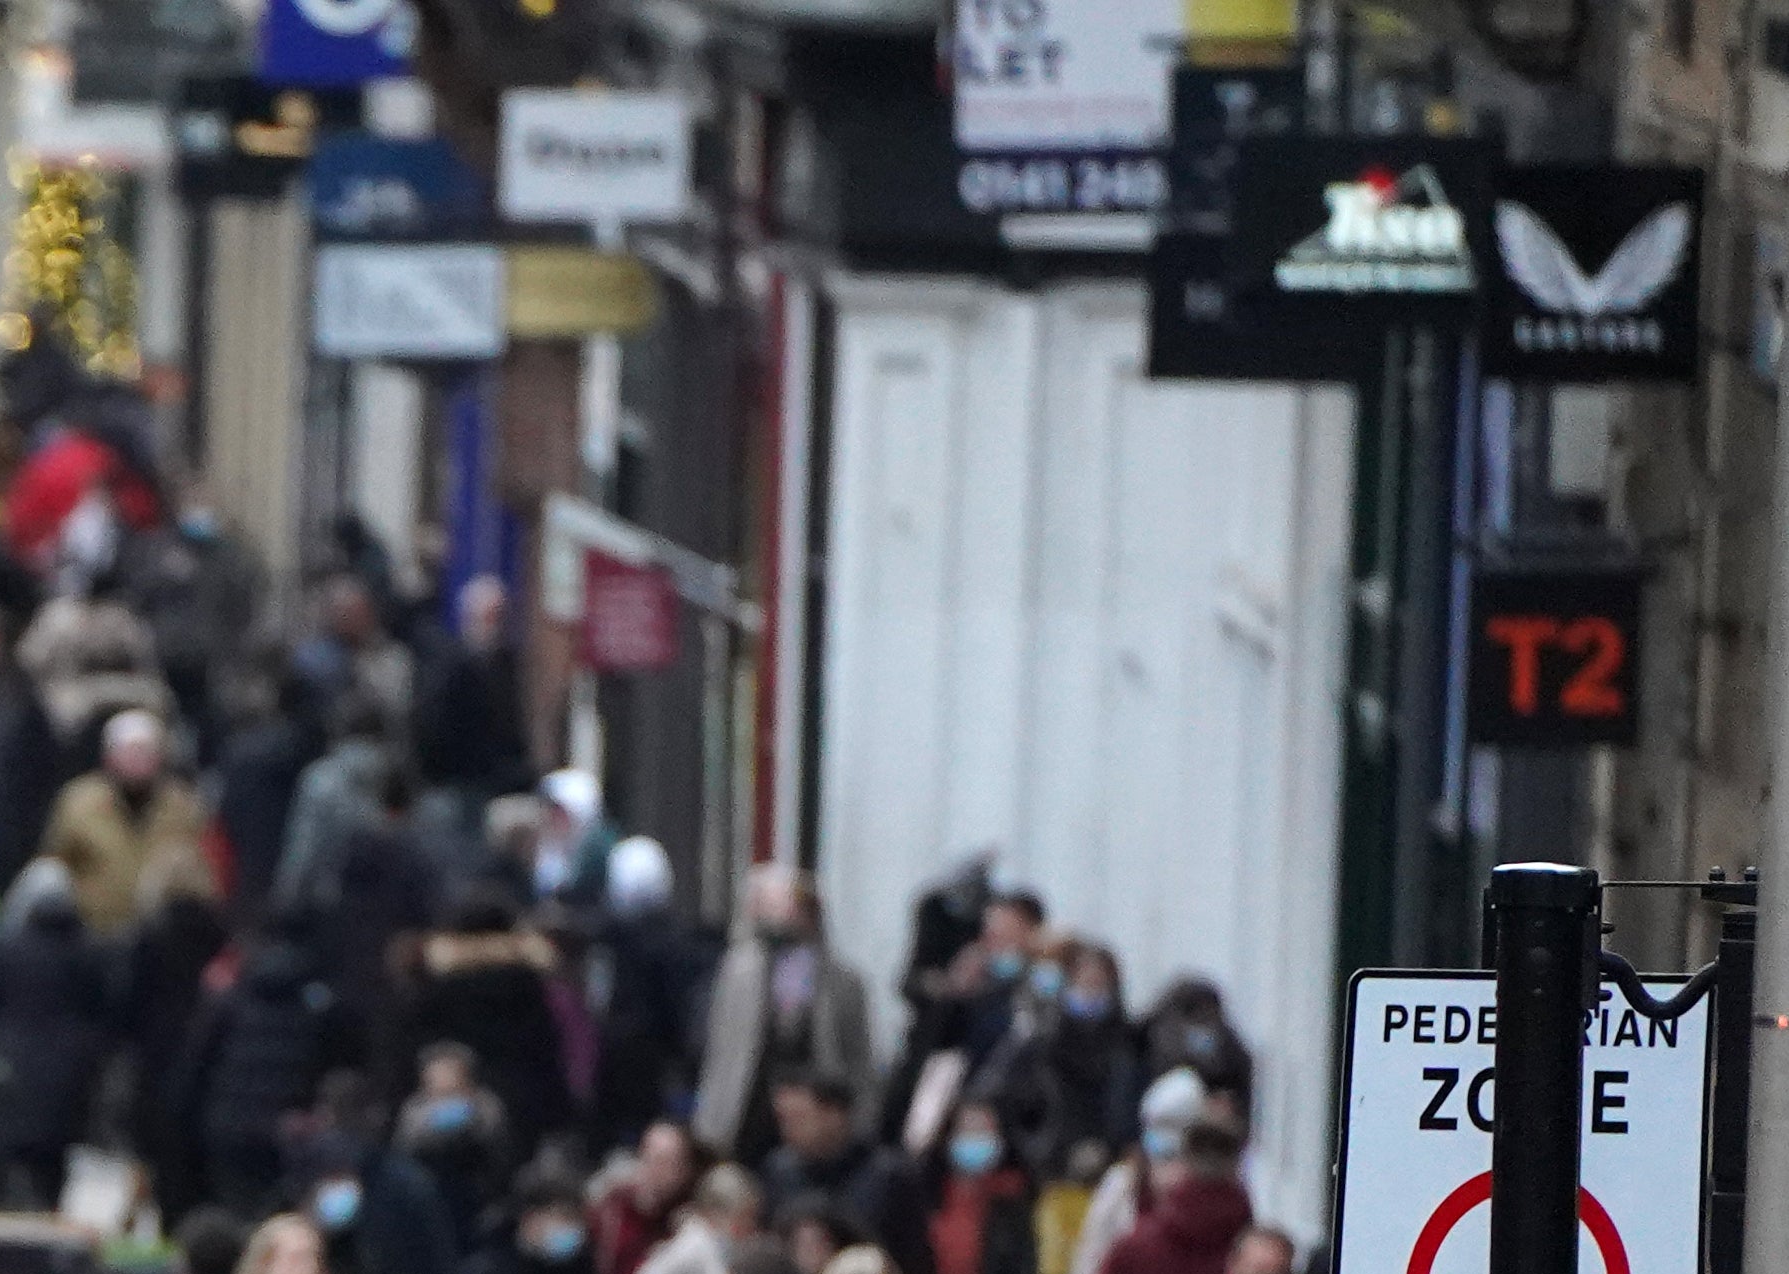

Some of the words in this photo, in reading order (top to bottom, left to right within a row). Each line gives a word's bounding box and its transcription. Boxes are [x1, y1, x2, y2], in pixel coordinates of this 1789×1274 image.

[1486, 616, 1625, 716] T2
[1383, 1004, 1678, 1048] PEDEIAN
[1419, 1067, 1629, 1133] ZOE
